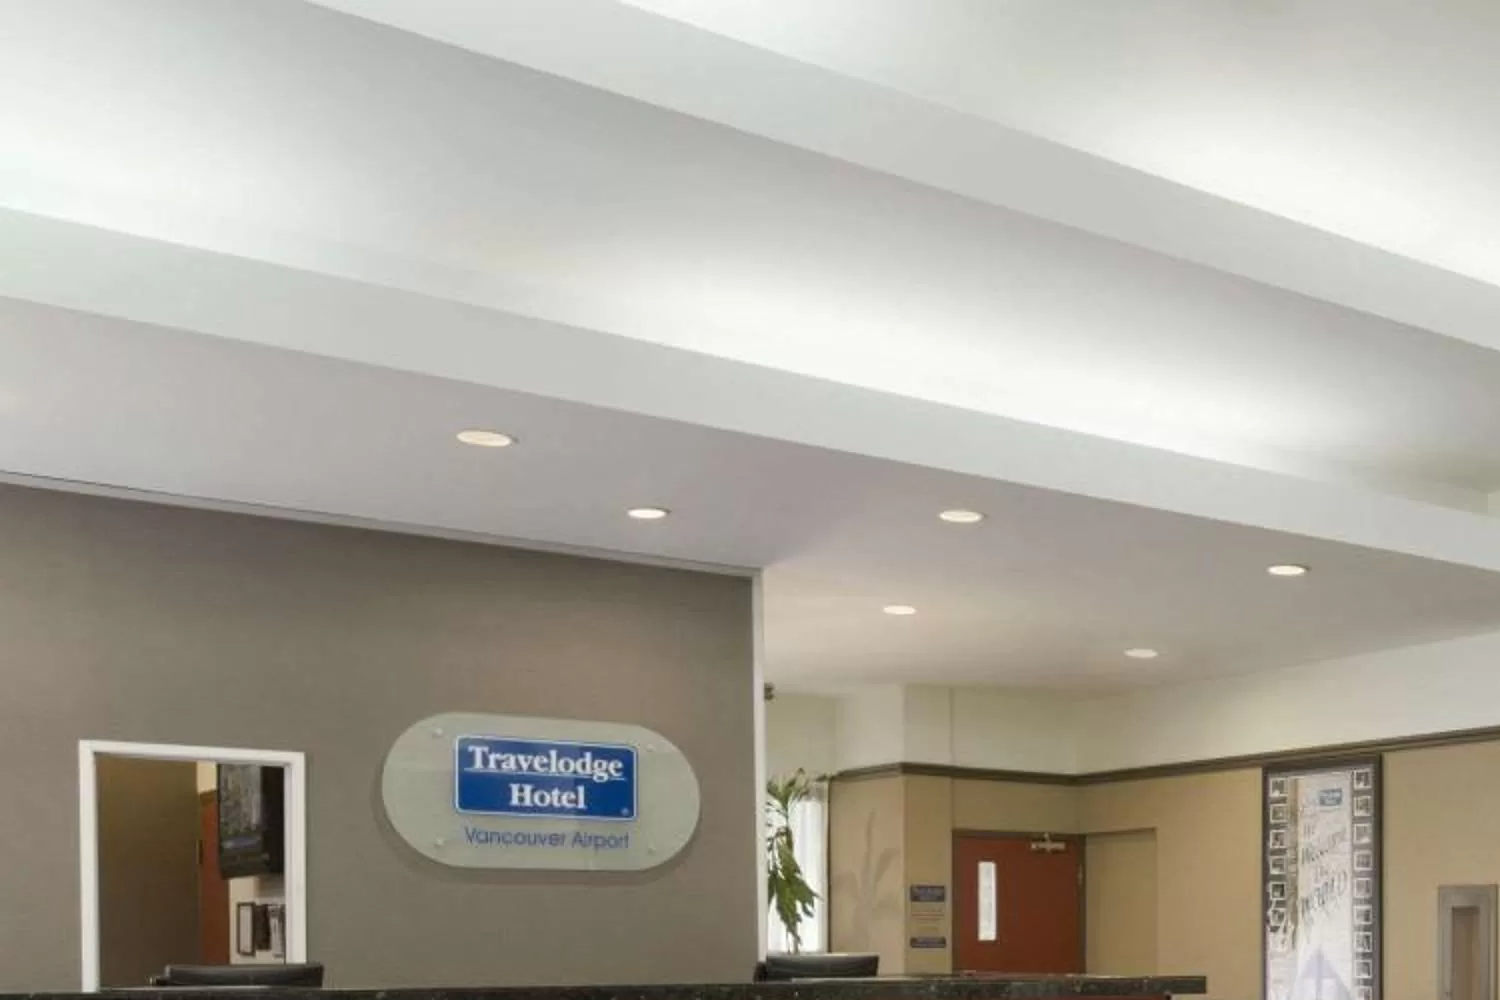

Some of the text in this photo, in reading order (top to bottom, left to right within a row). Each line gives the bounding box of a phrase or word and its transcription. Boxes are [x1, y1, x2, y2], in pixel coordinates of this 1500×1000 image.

[467, 745, 624, 783] Travelodge
[508, 783, 588, 810] Hotel
[463, 826, 630, 854] Vancouver Airport
